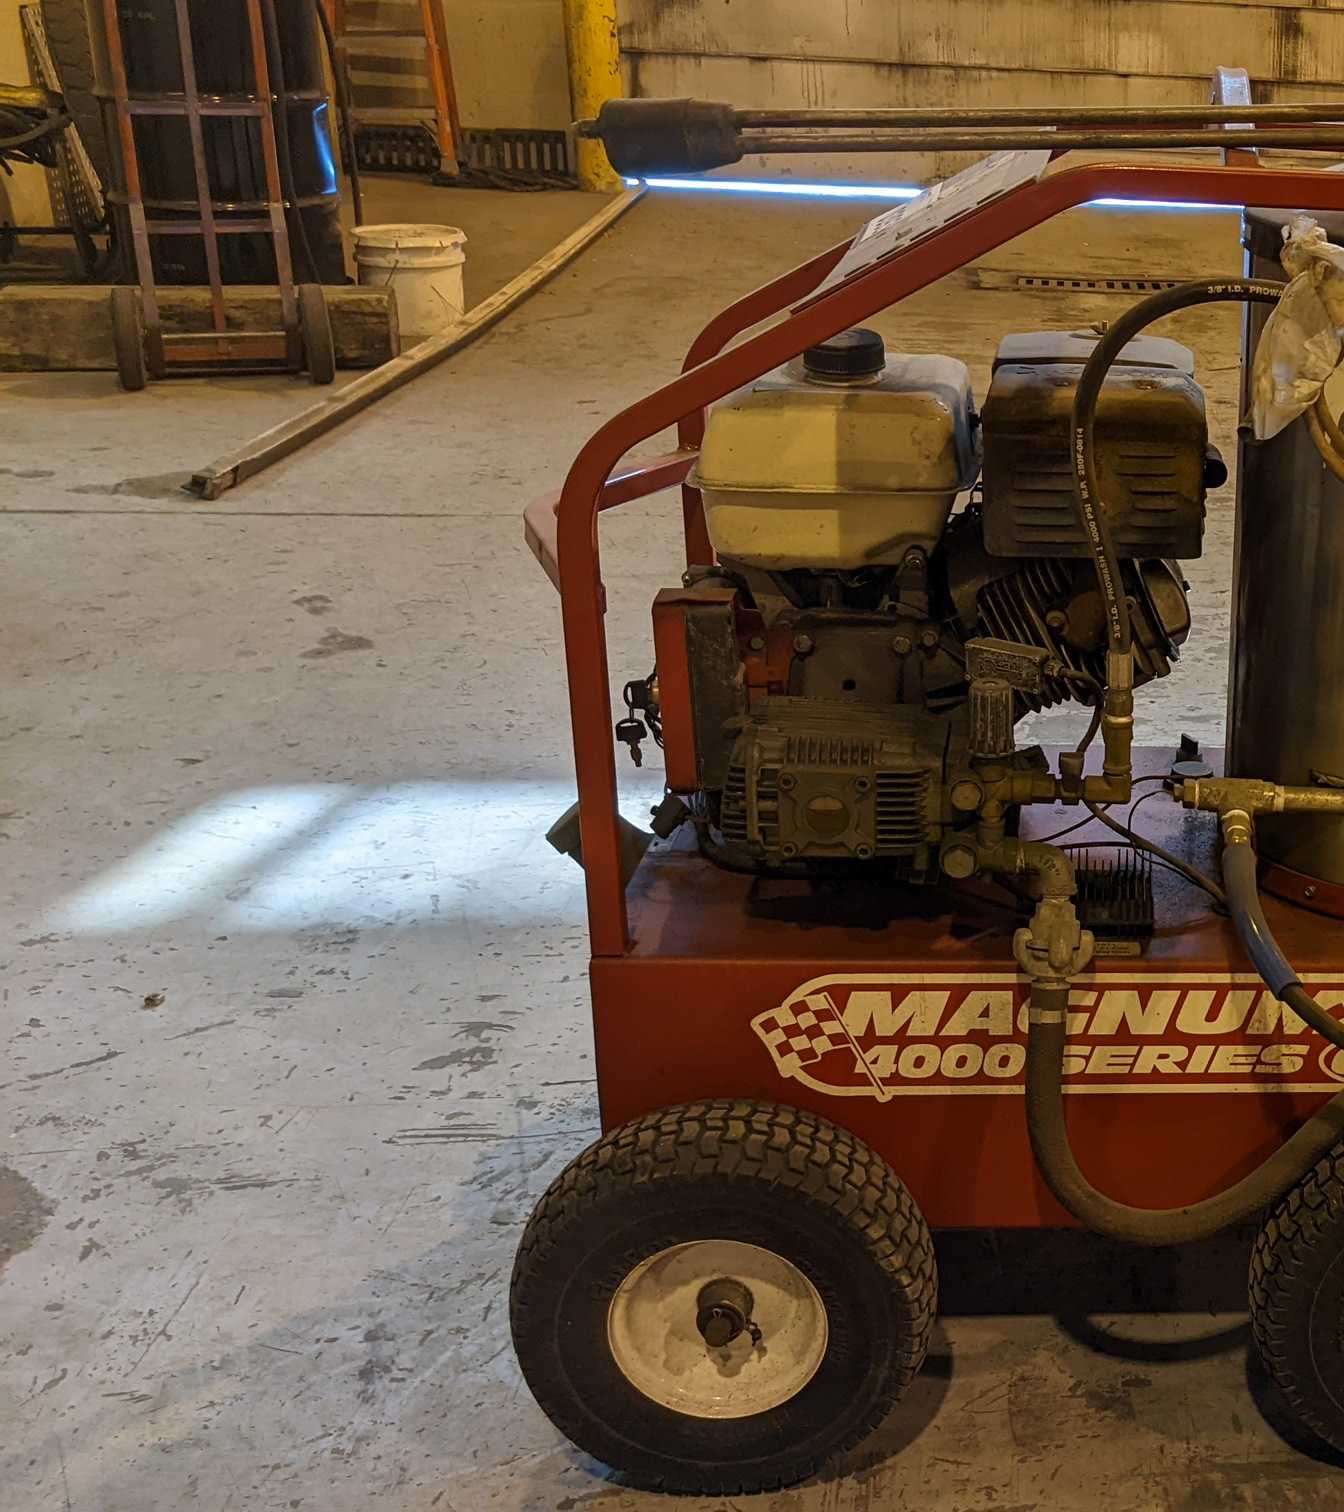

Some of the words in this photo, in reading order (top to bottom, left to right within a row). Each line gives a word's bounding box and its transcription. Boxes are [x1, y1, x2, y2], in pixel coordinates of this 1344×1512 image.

[1249, 286, 1283, 297] PROWA
[854, 1043, 1027, 1079] 4000
[1061, 1045, 1310, 1074] SERIES
